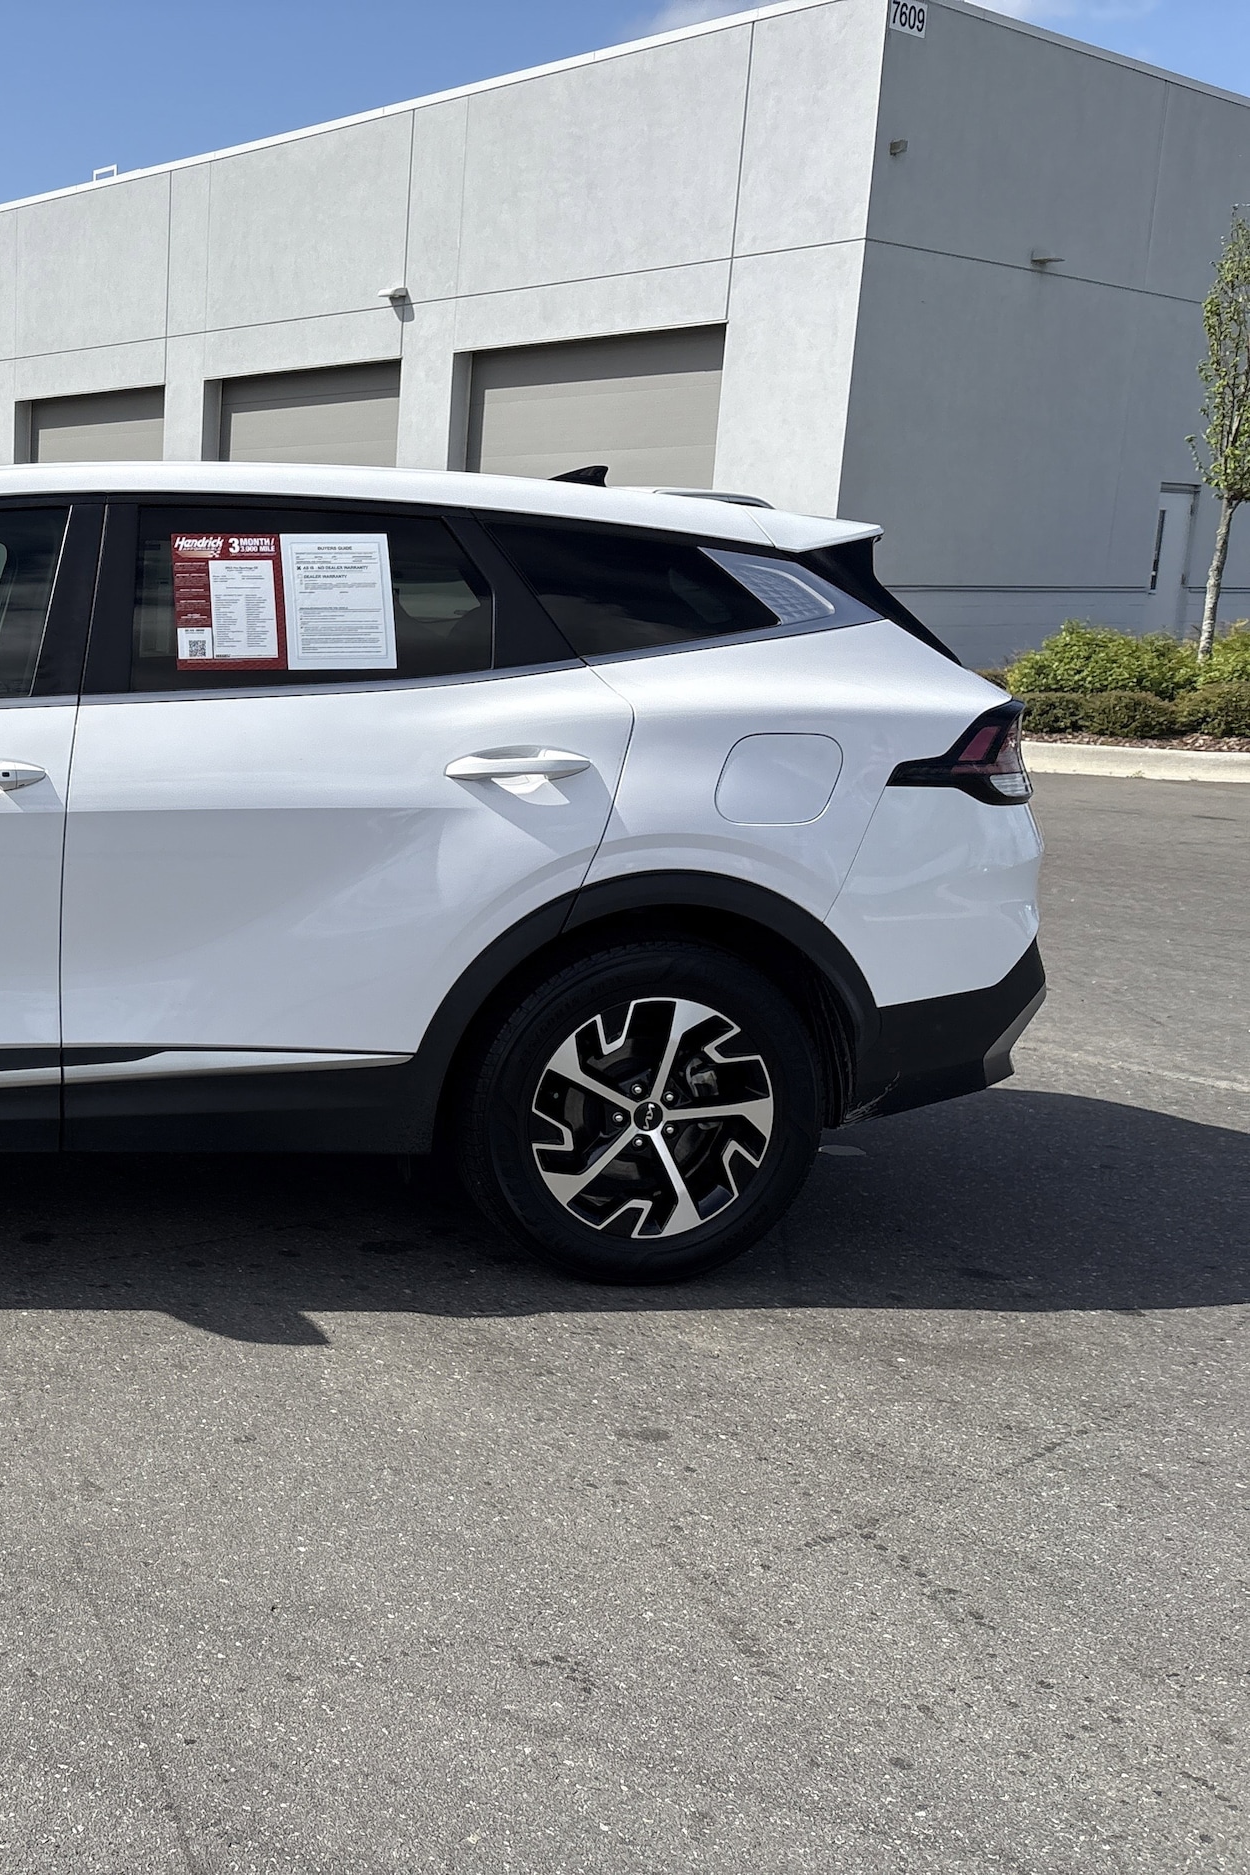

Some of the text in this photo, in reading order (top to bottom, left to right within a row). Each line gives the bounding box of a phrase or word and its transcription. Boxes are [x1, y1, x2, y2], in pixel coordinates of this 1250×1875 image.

[892, 0, 925, 33] 7609
[174, 536, 225, 551] Hendrick
[228, 538, 240, 553] 3
[240, 538, 275, 546] MONTH/
[240, 545, 258, 553] 3,000
